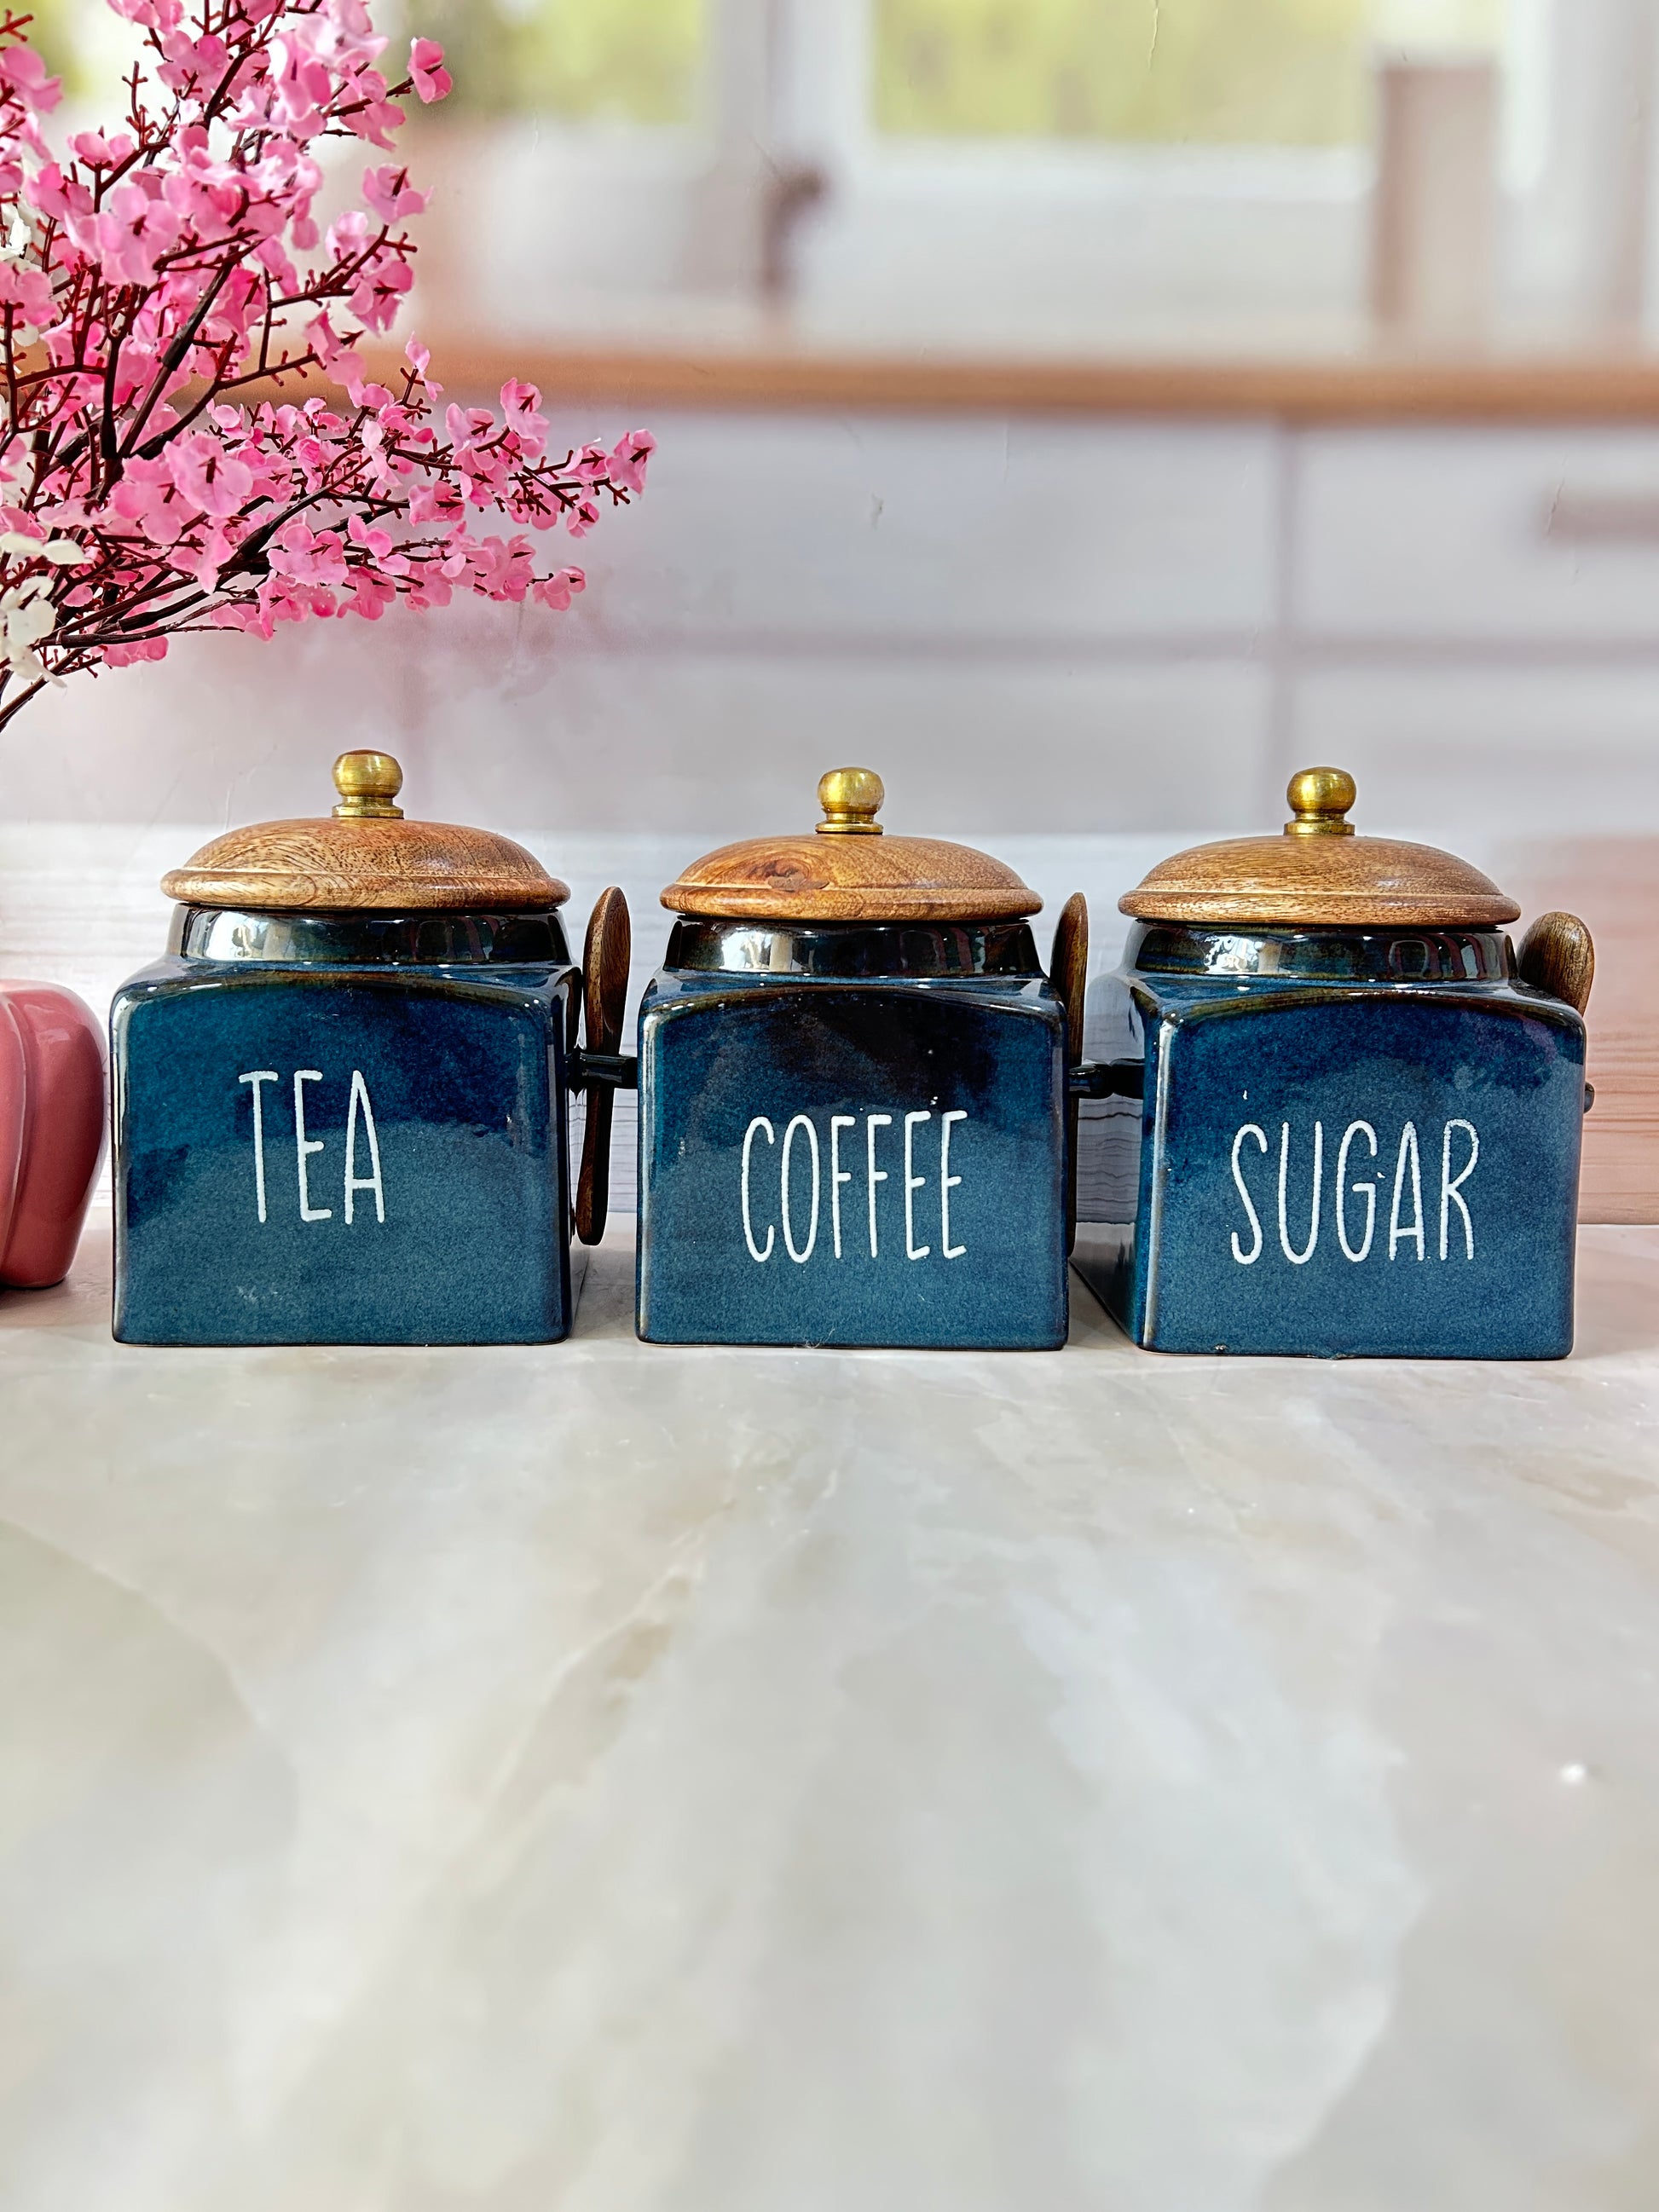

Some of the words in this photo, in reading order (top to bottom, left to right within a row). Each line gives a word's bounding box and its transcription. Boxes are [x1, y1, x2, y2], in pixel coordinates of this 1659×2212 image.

[238, 1069, 384, 1225] TEA
[741, 1110, 968, 1263] COFFEE
[1230, 1118, 1480, 1265] SUGAR
